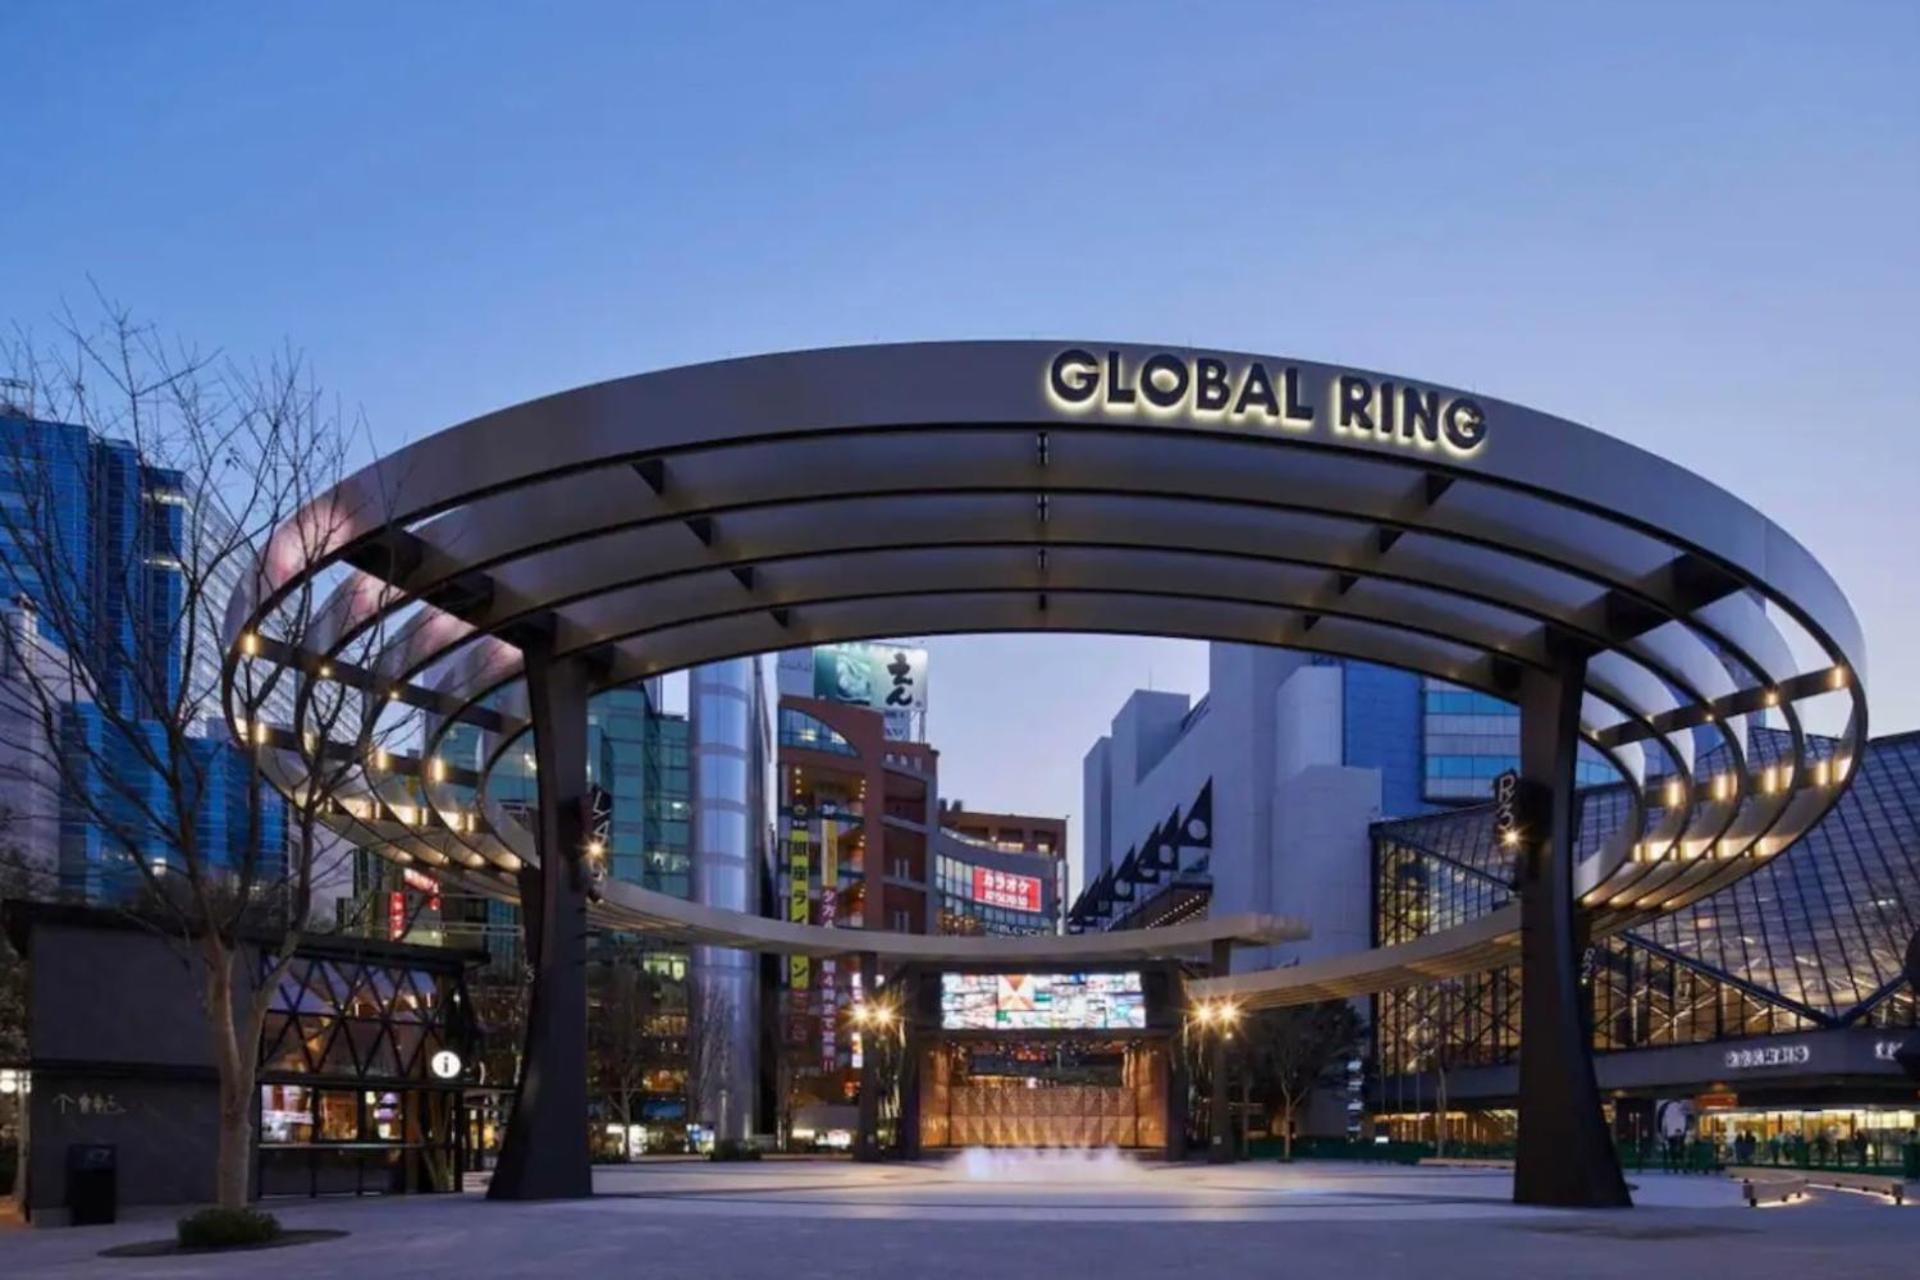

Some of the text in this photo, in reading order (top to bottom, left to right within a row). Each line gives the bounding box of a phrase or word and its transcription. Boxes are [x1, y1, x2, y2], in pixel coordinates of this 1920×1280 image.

[1051, 349, 1488, 449] GLOBAL RING
[886, 652, 913, 706] えん
[984, 870, 1031, 893] カラオケ
